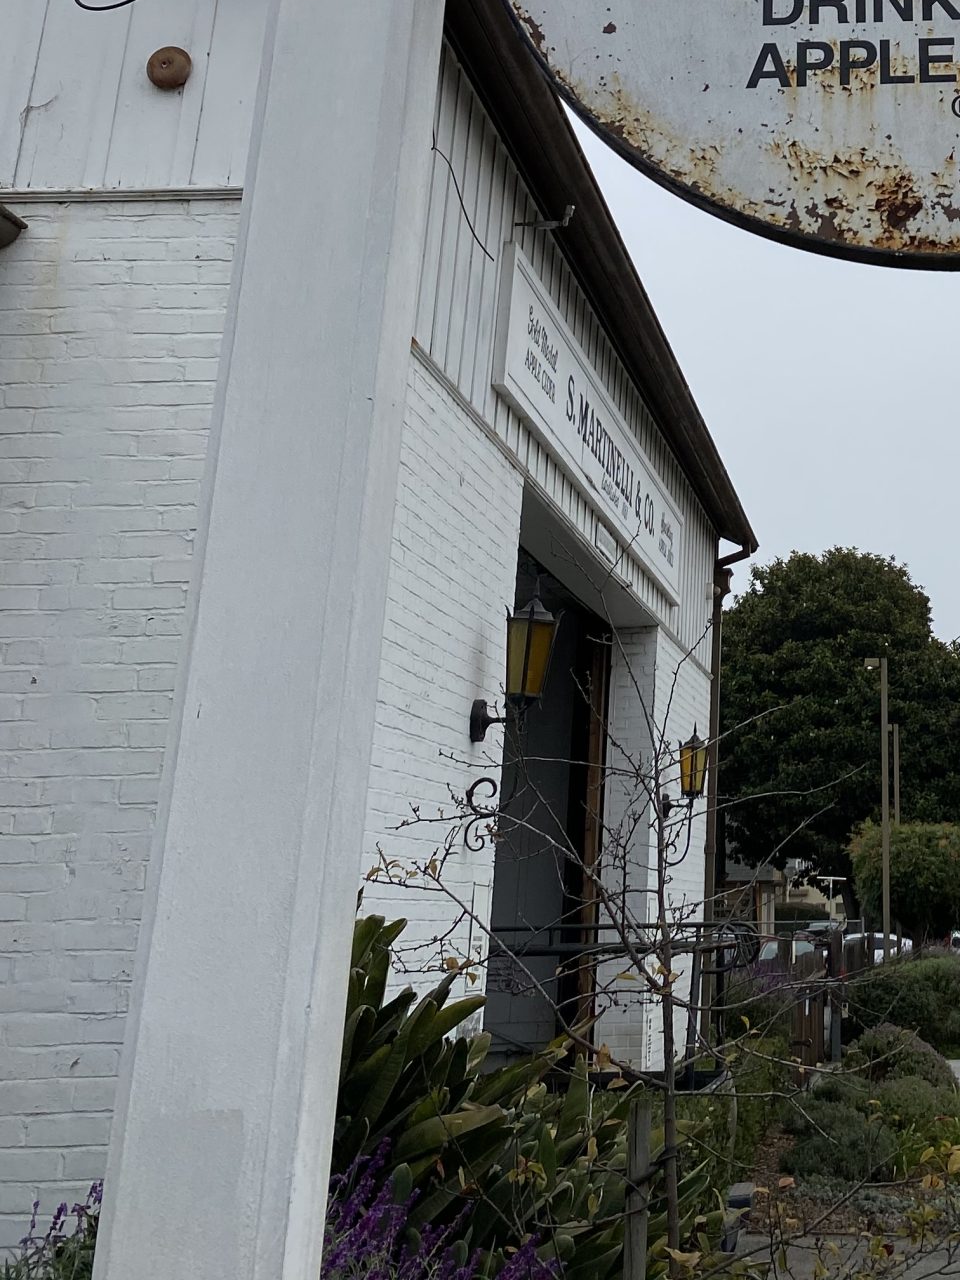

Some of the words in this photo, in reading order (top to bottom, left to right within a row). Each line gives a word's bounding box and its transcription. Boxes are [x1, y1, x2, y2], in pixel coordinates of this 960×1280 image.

[745, 36, 957, 90] APPLE
[566, 373, 576, 426] S.
[577, 391, 634, 508] MARTINELLI
[635, 479, 642, 518] &
[644, 492, 655, 538] CO.
